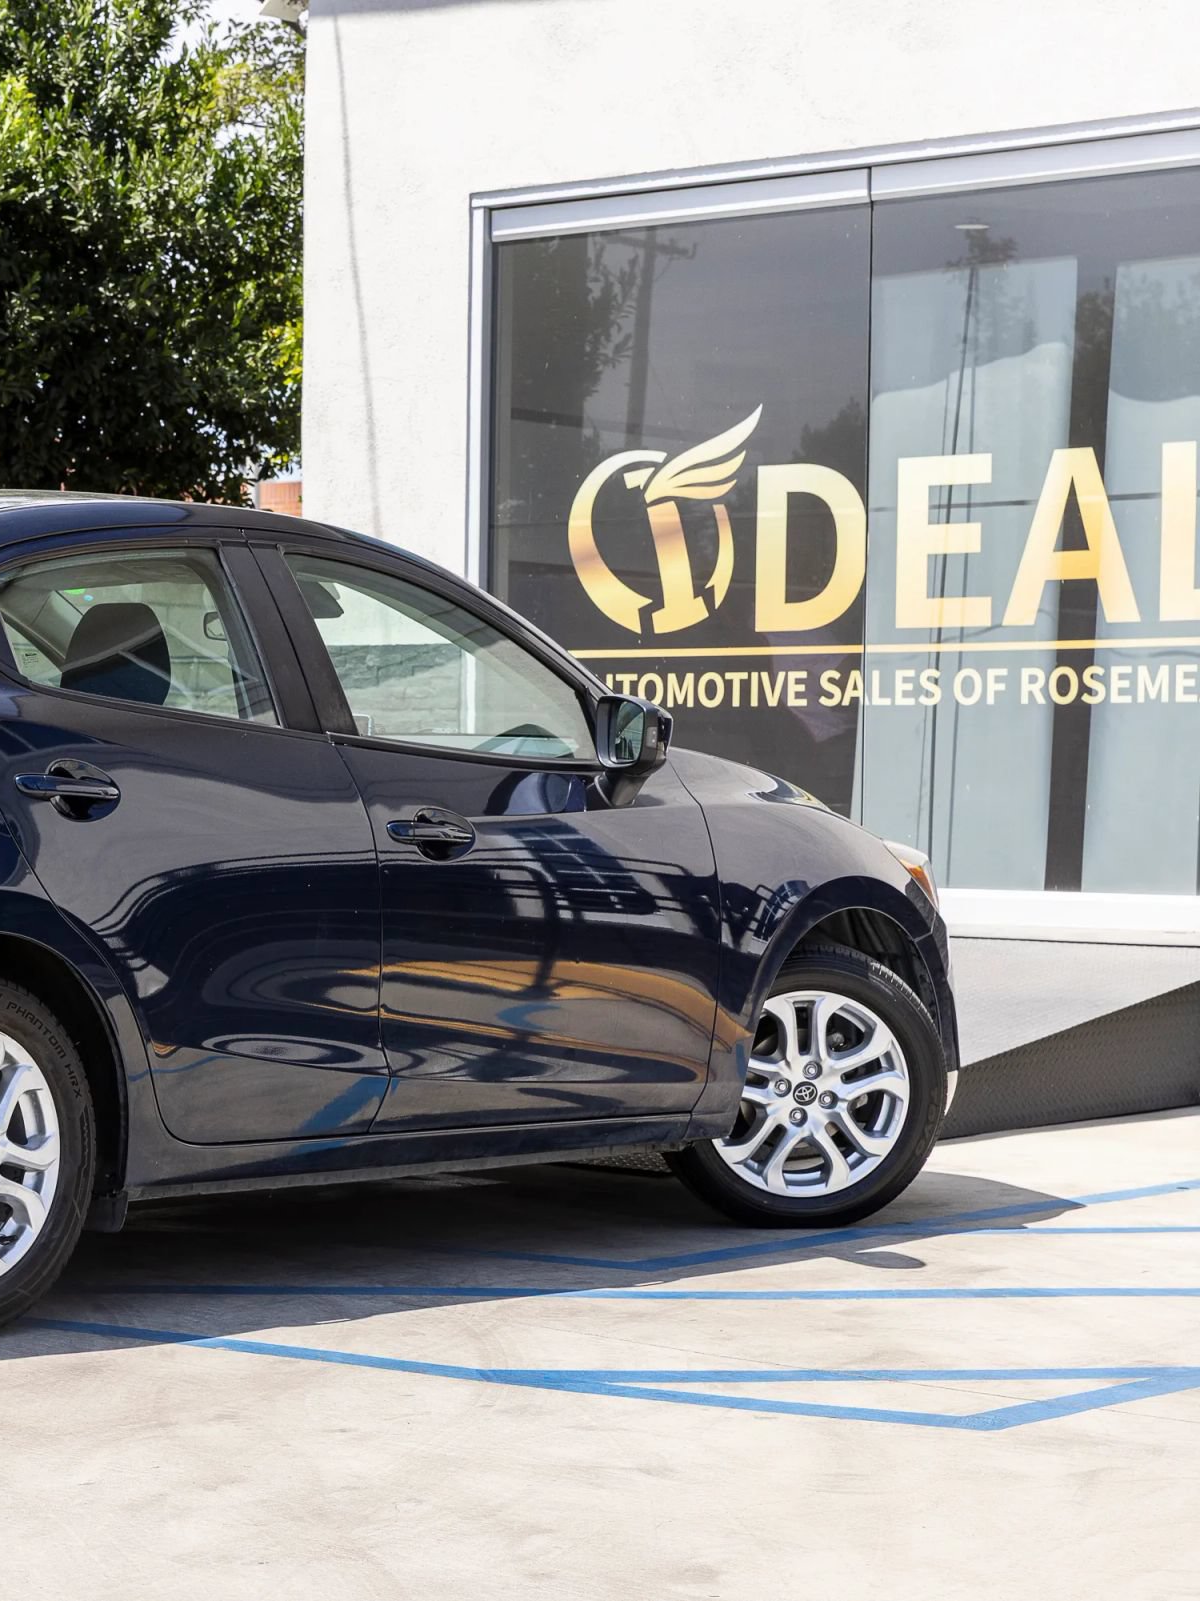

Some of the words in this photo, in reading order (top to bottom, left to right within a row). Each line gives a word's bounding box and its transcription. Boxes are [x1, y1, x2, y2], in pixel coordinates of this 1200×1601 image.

[605, 670, 808, 709] TOMOTIVE
[818, 667, 942, 707] SALES
[953, 667, 1008, 706] OF
[1020, 663, 1199, 706] ROSEME
[6, 1001, 66, 1060] PHANTOM
[64, 1063, 83, 1100] HRX
